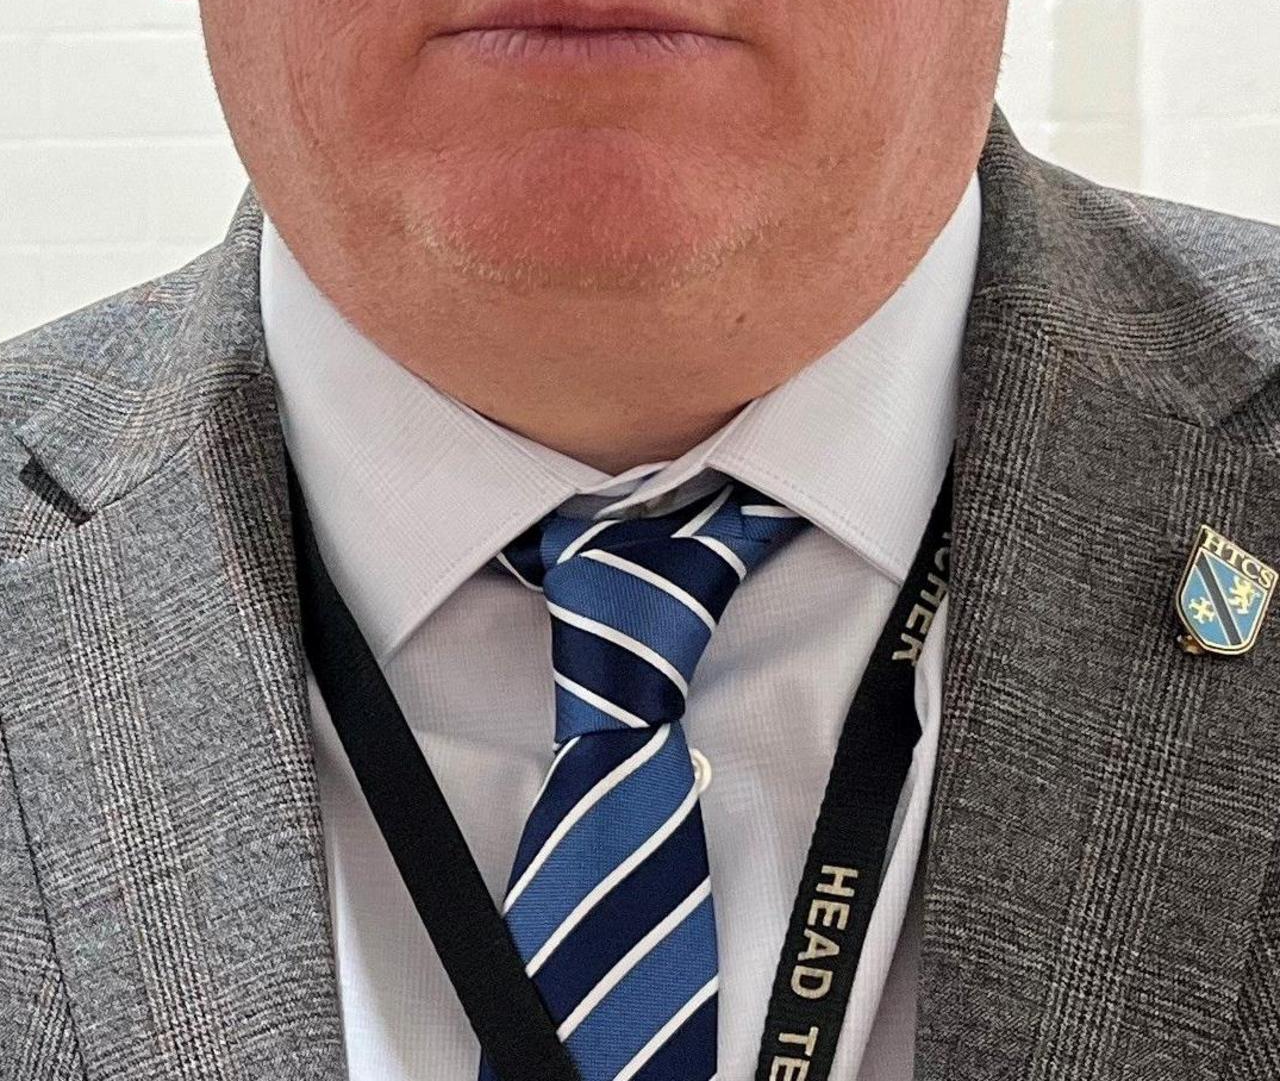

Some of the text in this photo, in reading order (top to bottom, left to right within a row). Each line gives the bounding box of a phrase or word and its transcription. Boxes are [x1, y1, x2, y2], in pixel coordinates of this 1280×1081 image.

[892, 532, 952, 666] CHER
[1202, 530, 1274, 589] HTCS
[791, 864, 859, 1000] HEAD
